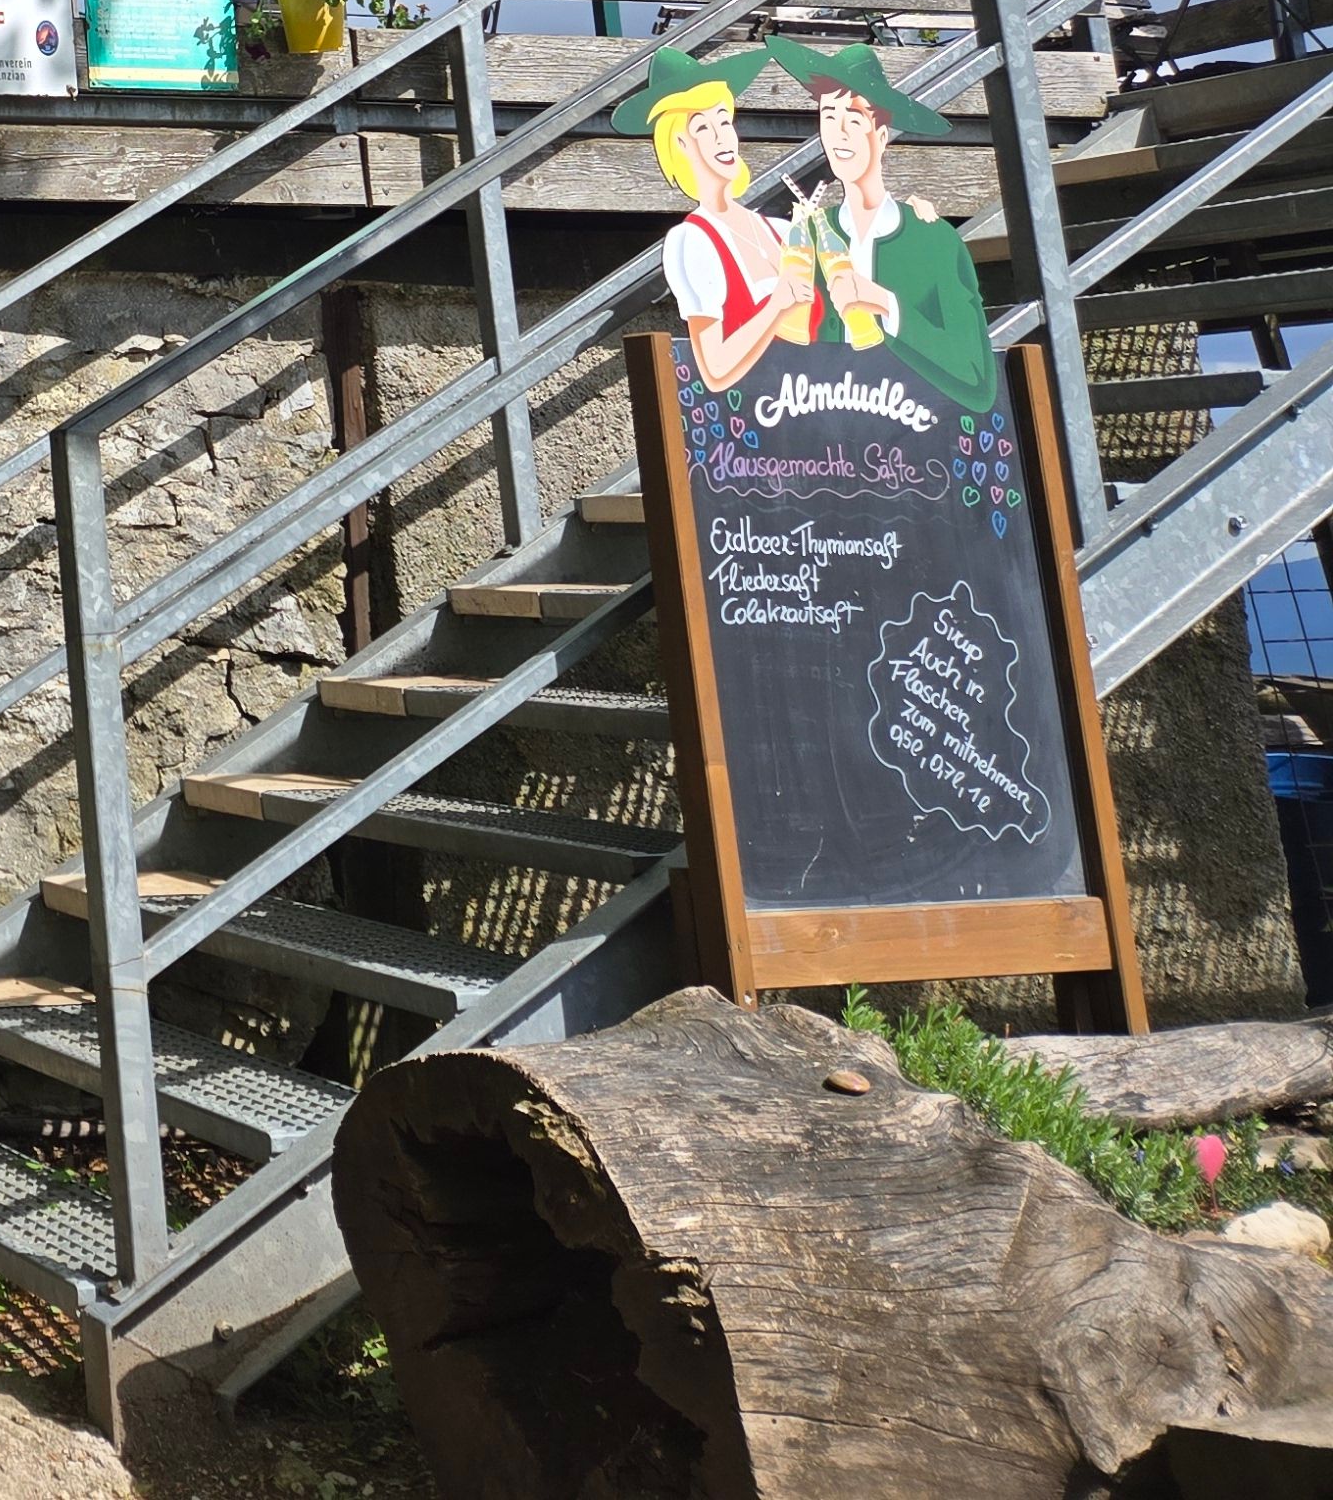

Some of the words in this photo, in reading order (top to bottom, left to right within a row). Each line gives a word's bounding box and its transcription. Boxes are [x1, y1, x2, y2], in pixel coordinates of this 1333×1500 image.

[754, 371, 931, 432] Almdudler
[709, 442, 856, 492] Hausgemachte
[860, 442, 924, 489] Säfte
[709, 515, 904, 569] Erdbeer-Thymiansaft
[708, 554, 821, 601] Fliedersaft
[720, 598, 865, 634] Colakrautsaft
[933, 608, 983, 665] Sirup
[888, 660, 970, 733] Flaschen
[909, 637, 963, 691] Auch
[965, 679, 985, 704] in
[942, 732, 1033, 815] mitnehmen
